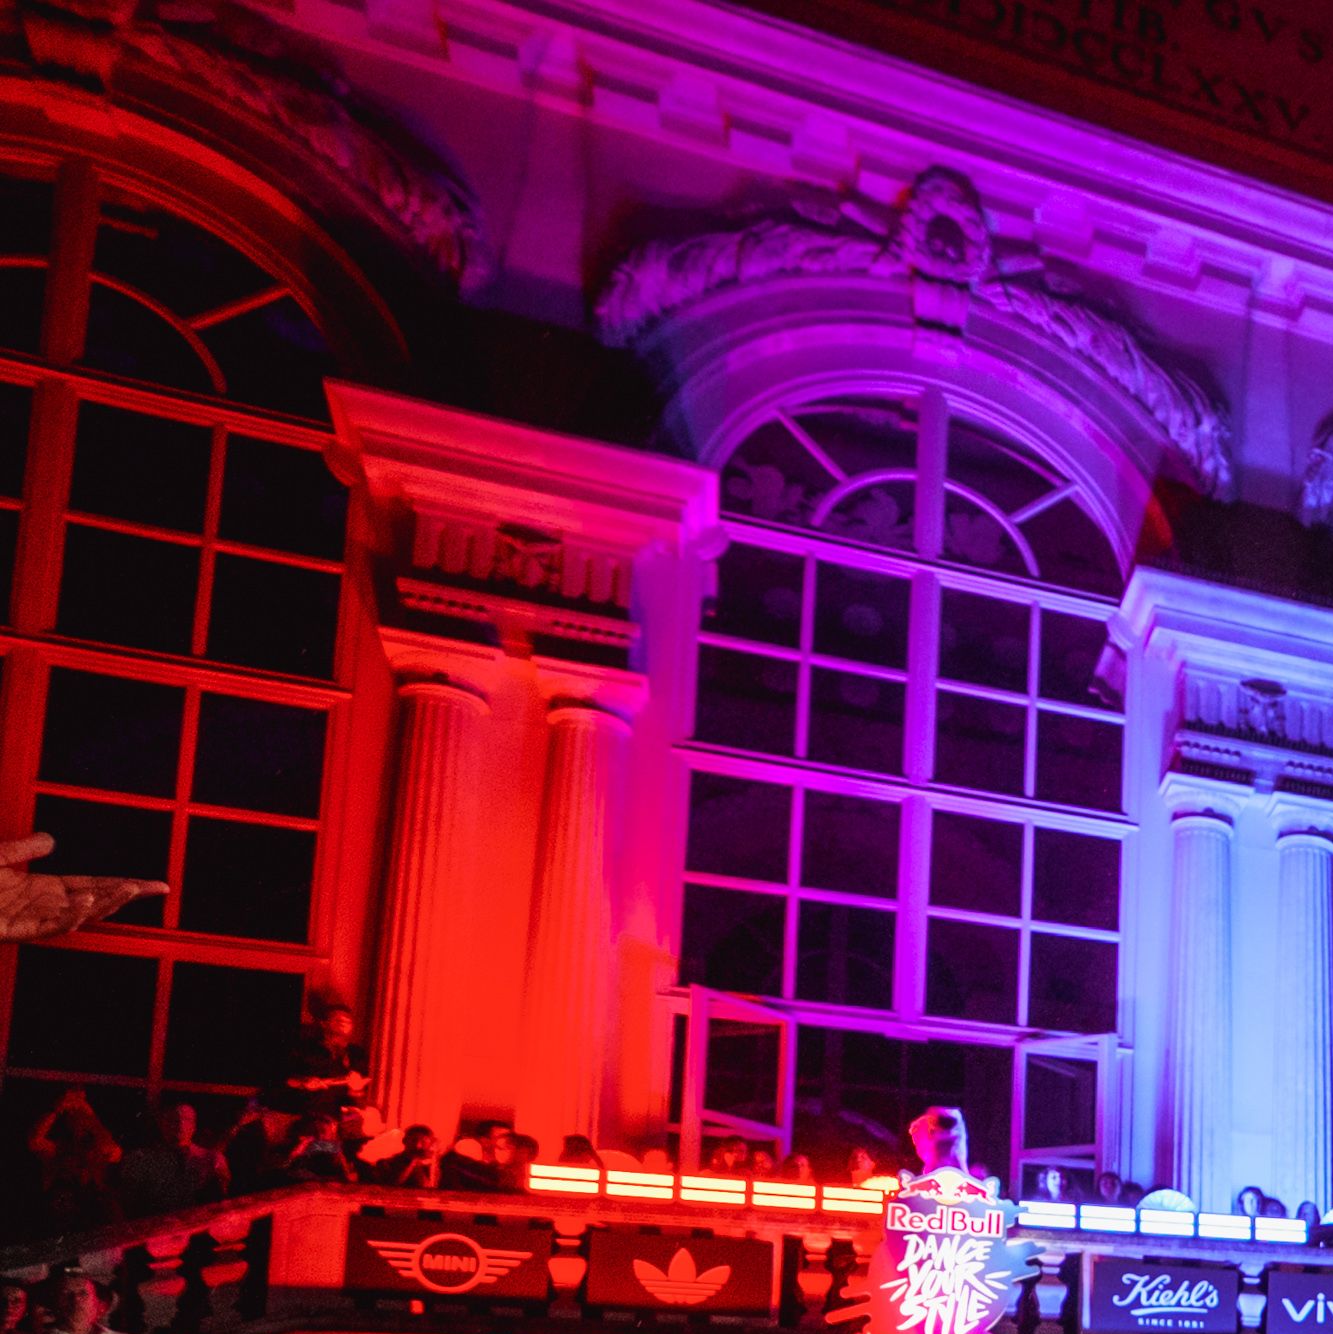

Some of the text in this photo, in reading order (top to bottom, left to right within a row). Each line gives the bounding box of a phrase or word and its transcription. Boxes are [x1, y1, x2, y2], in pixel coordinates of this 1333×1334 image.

[888, 1203, 1002, 1236] Red Bull
[423, 1253, 477, 1272] MINI
[897, 1234, 994, 1271] DANCE
[905, 1260, 998, 1301] YOUR
[1113, 1273, 1219, 1308] Kiehl's
